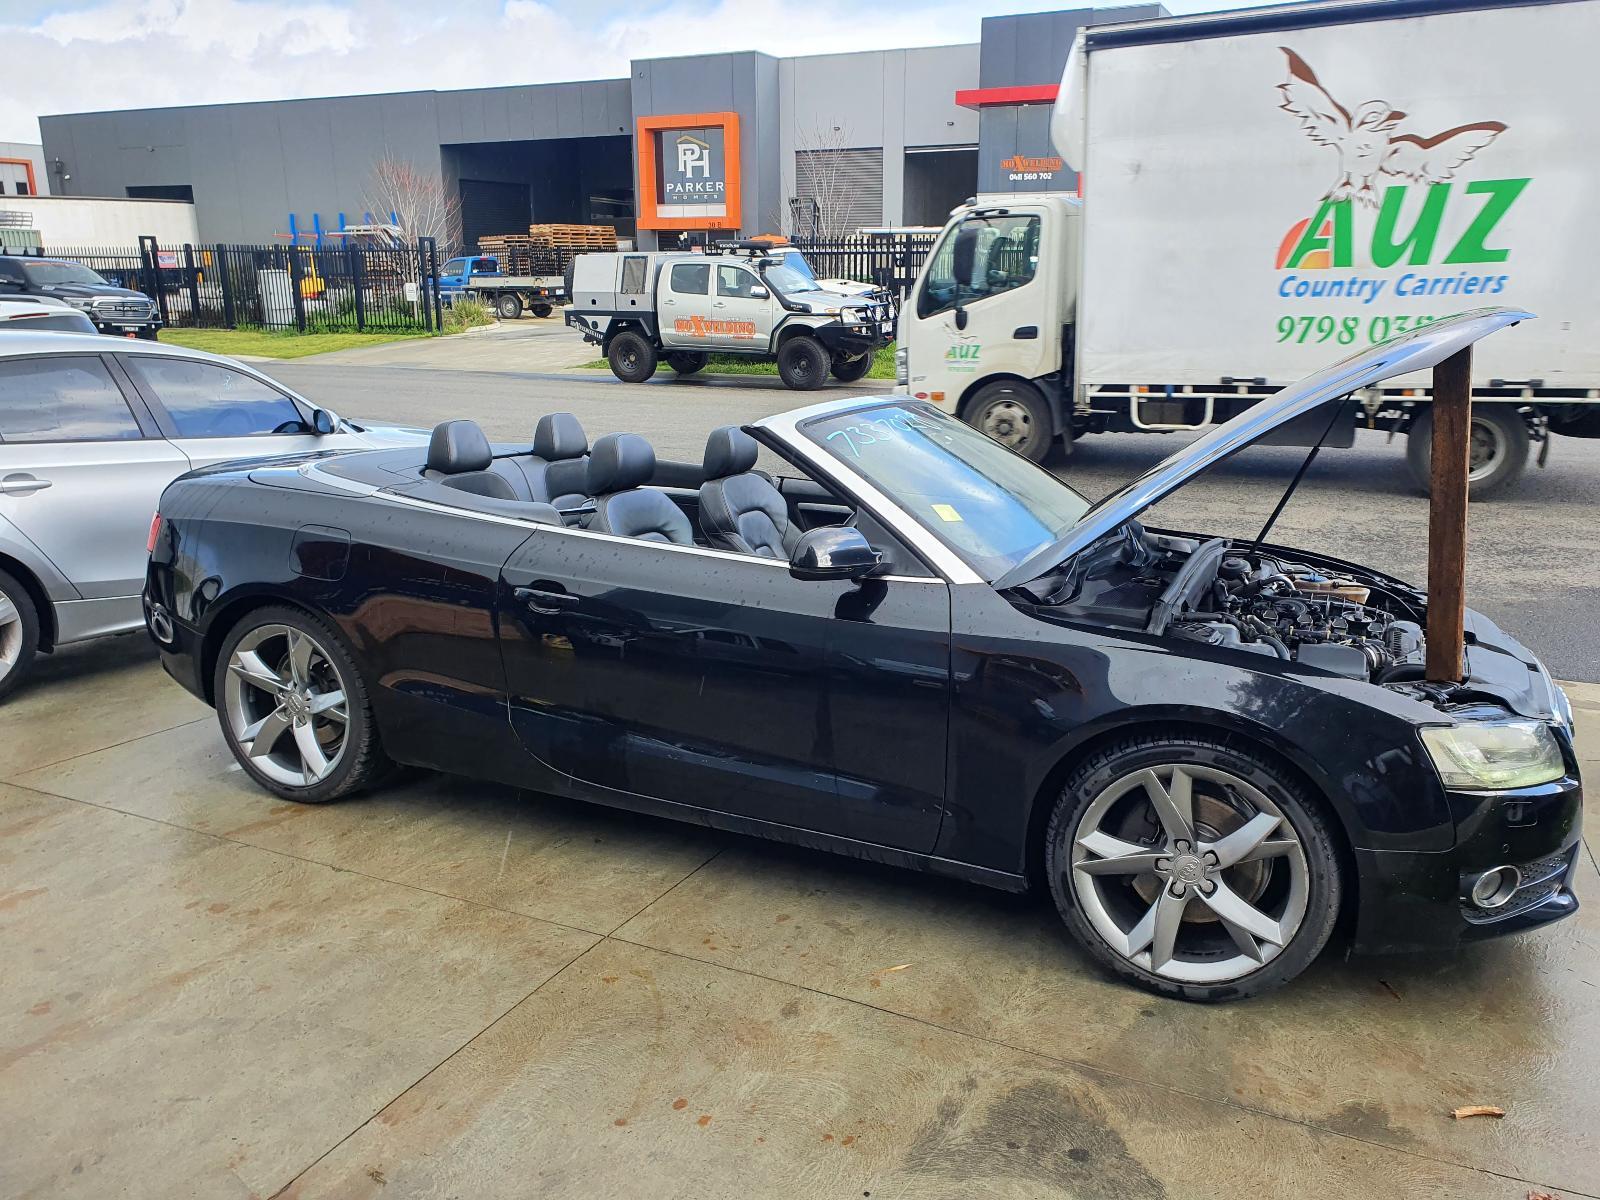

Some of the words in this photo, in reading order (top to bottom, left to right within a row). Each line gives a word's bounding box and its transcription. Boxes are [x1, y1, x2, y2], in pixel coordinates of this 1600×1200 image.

[1024, 173, 1038, 181] 560
[666, 182, 725, 193] PARKER
[1278, 274, 1388, 304] Country
[1394, 271, 1508, 297] Carriers
[1276, 315, 1358, 345] 9798
